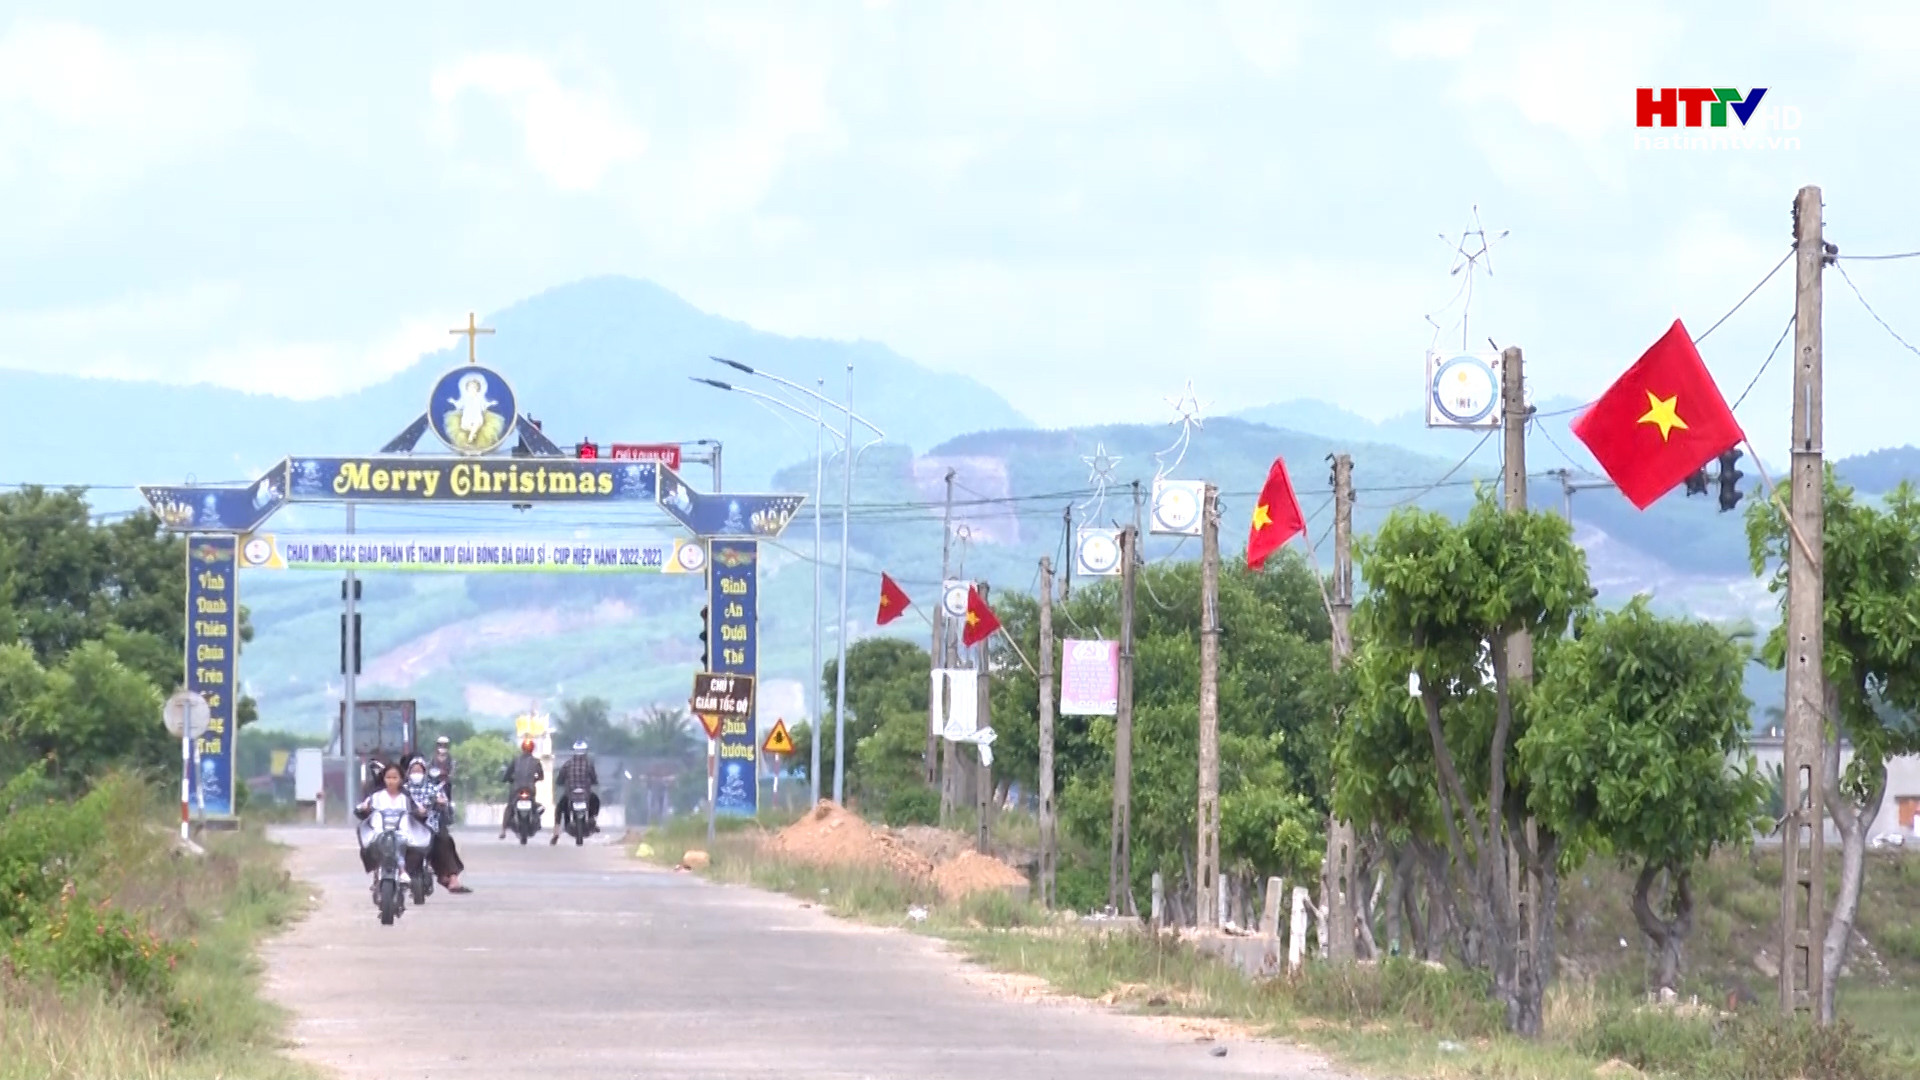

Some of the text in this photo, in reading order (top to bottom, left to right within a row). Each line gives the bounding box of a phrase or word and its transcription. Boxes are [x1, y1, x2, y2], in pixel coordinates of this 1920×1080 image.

[333, 462, 613, 497] Merry Christmas
[418, 545, 441, 563] THAM
[620, 547, 662, 567] 2022-2023
[724, 601, 744, 619] An
[721, 742, 755, 761] hương
